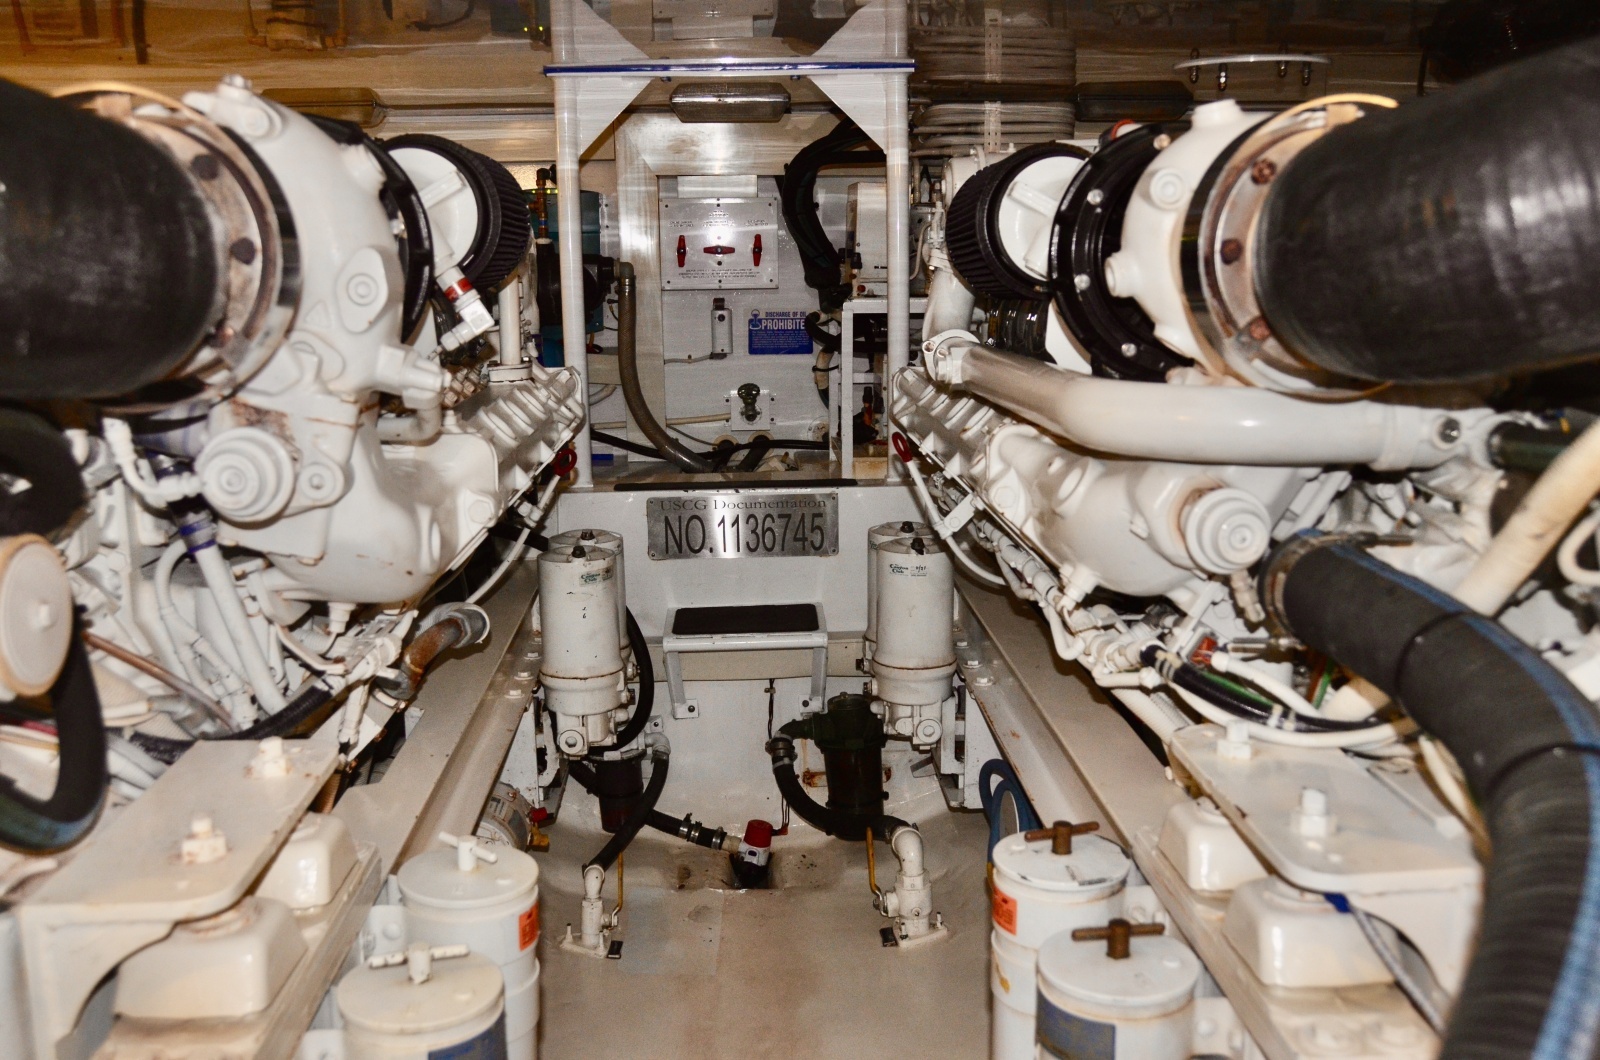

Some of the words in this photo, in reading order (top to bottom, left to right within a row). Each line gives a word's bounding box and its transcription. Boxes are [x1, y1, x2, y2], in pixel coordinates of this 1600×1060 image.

[761, 319, 805, 330] PROHIBITE
[660, 500, 708, 511] USCG
[714, 499, 826, 510] Documentation
[665, 513, 824, 554] NO.1136745
